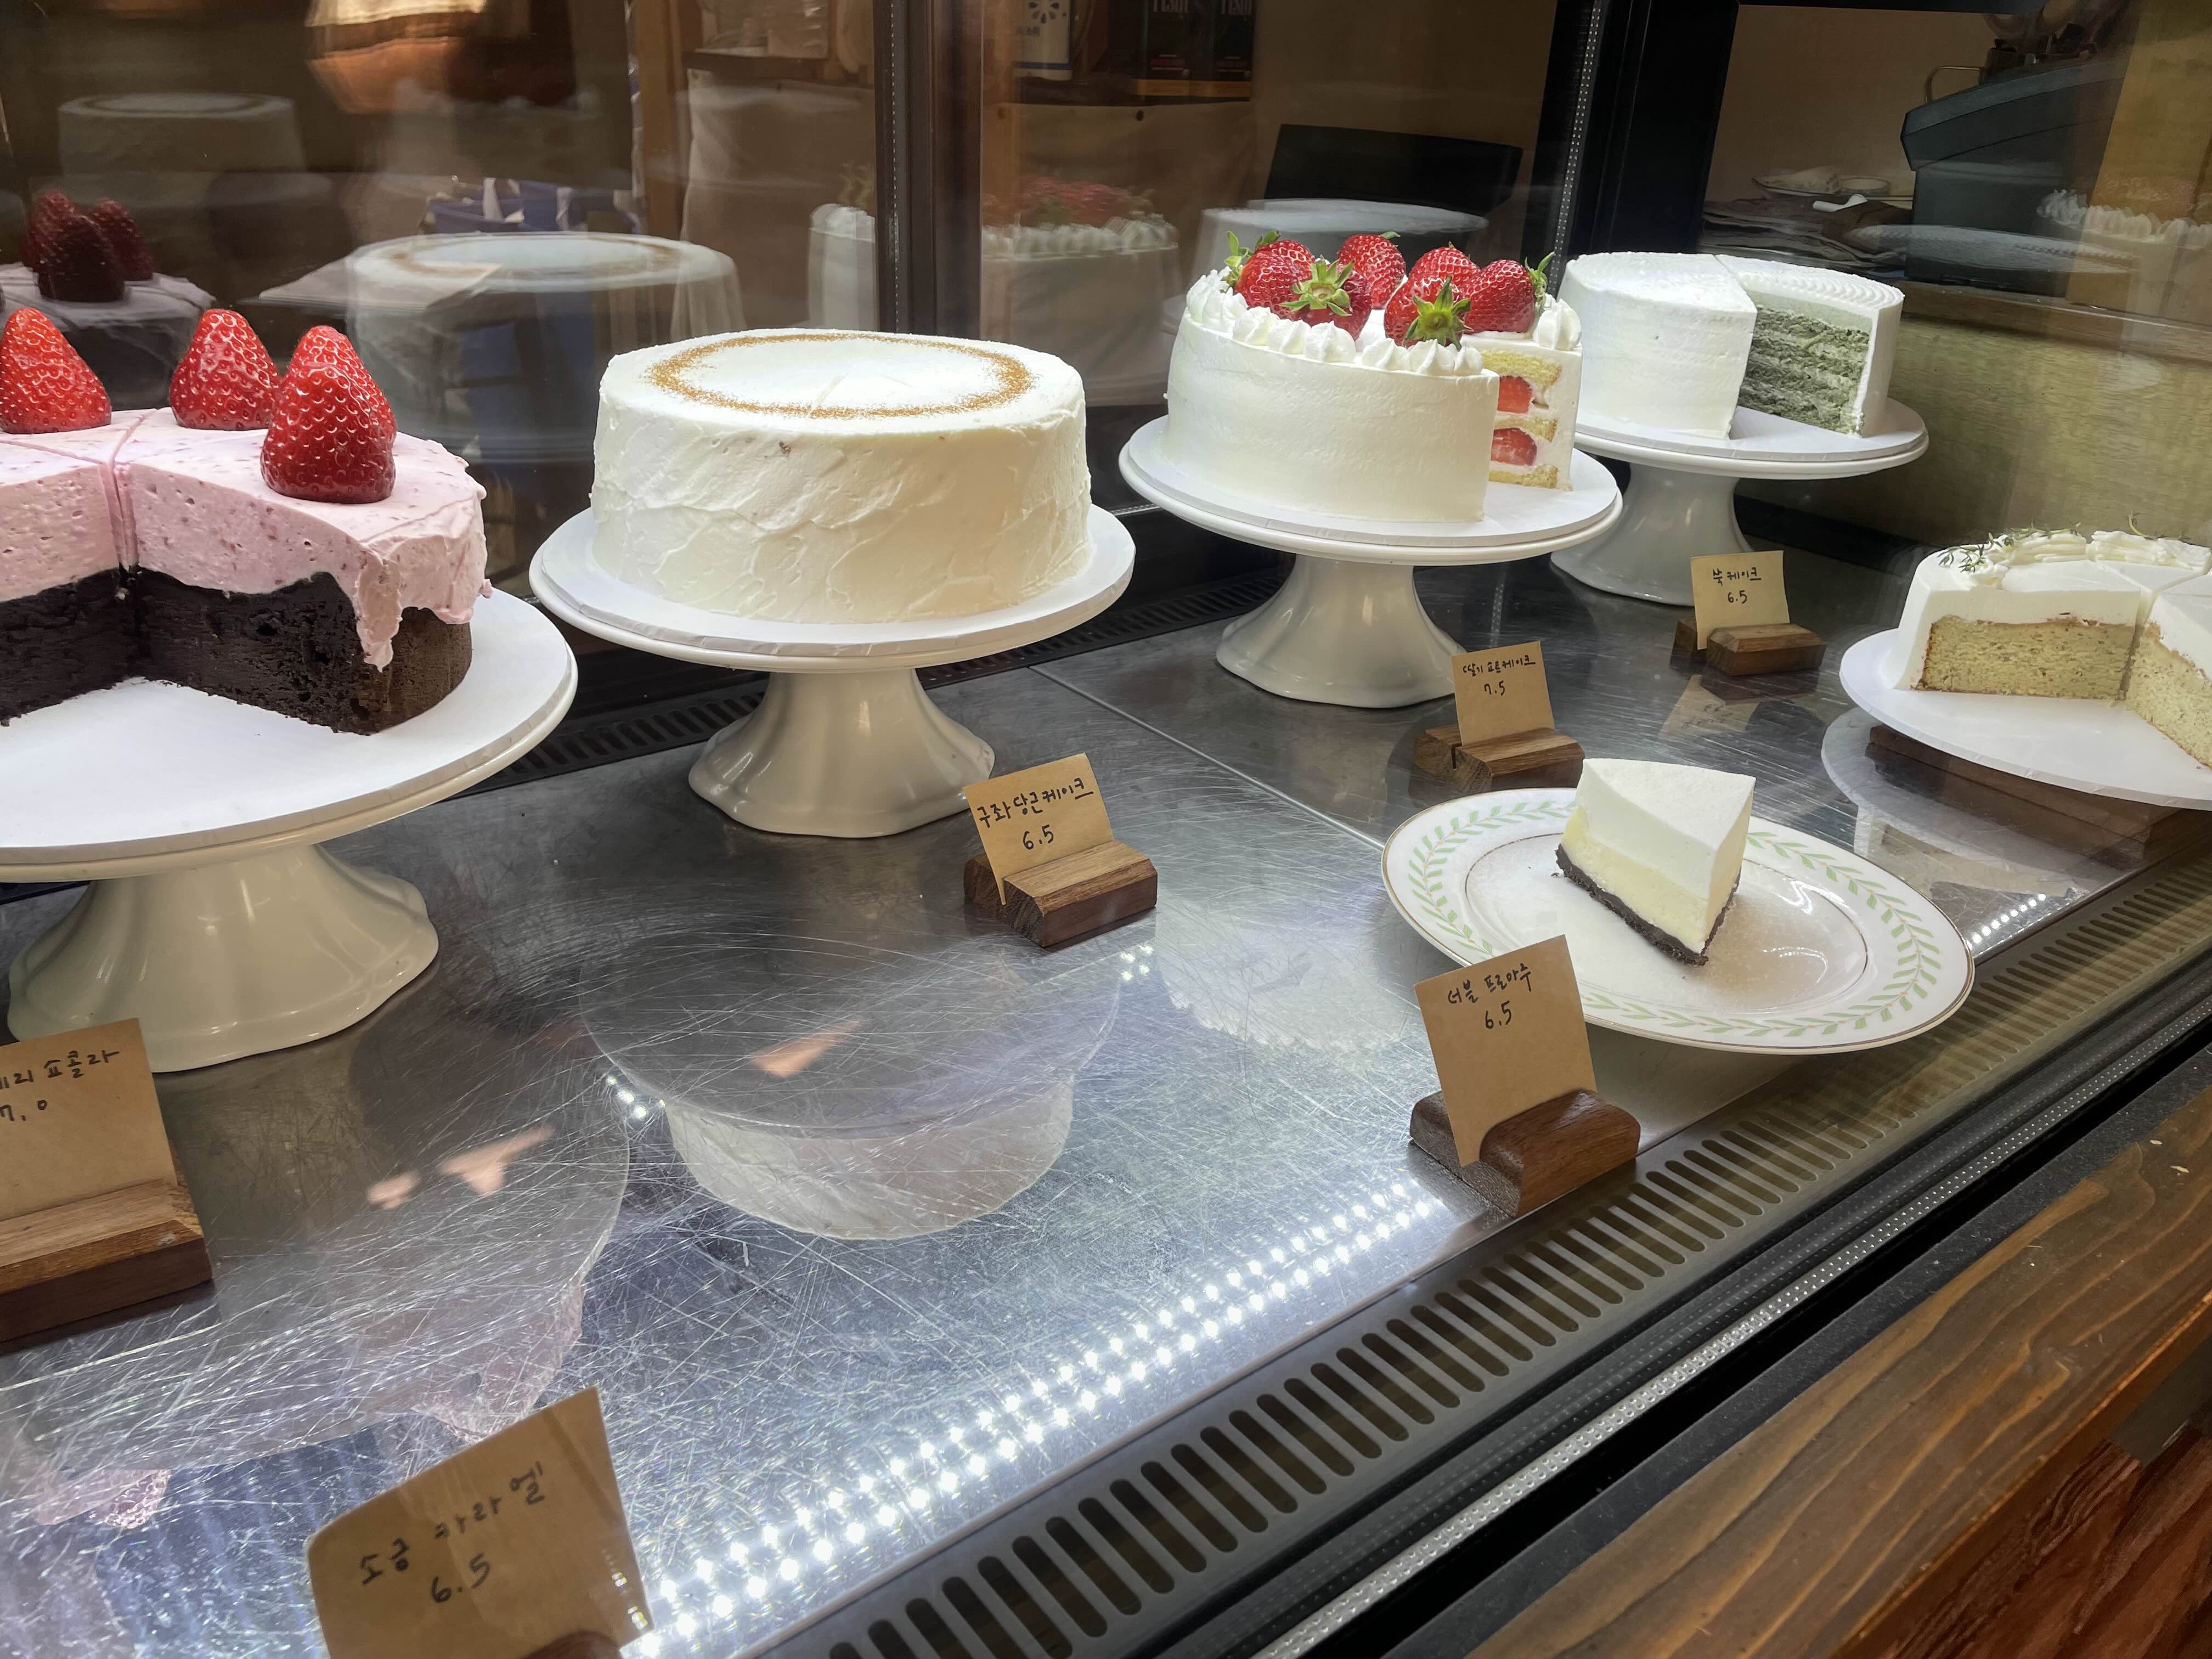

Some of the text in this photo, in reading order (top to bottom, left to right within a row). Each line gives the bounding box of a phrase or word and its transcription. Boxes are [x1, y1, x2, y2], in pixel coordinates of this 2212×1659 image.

[1728, 590, 1747, 603] 6.5
[1484, 680, 1505, 696] 7.5
[1023, 825, 1054, 850] 6.5
[1448, 979, 1479, 1003] 더블
[1485, 1001, 1511, 1029] 6.5
[359, 1461, 545, 1585] 소금 카라멜
[430, 1553, 491, 1602] 6.5
